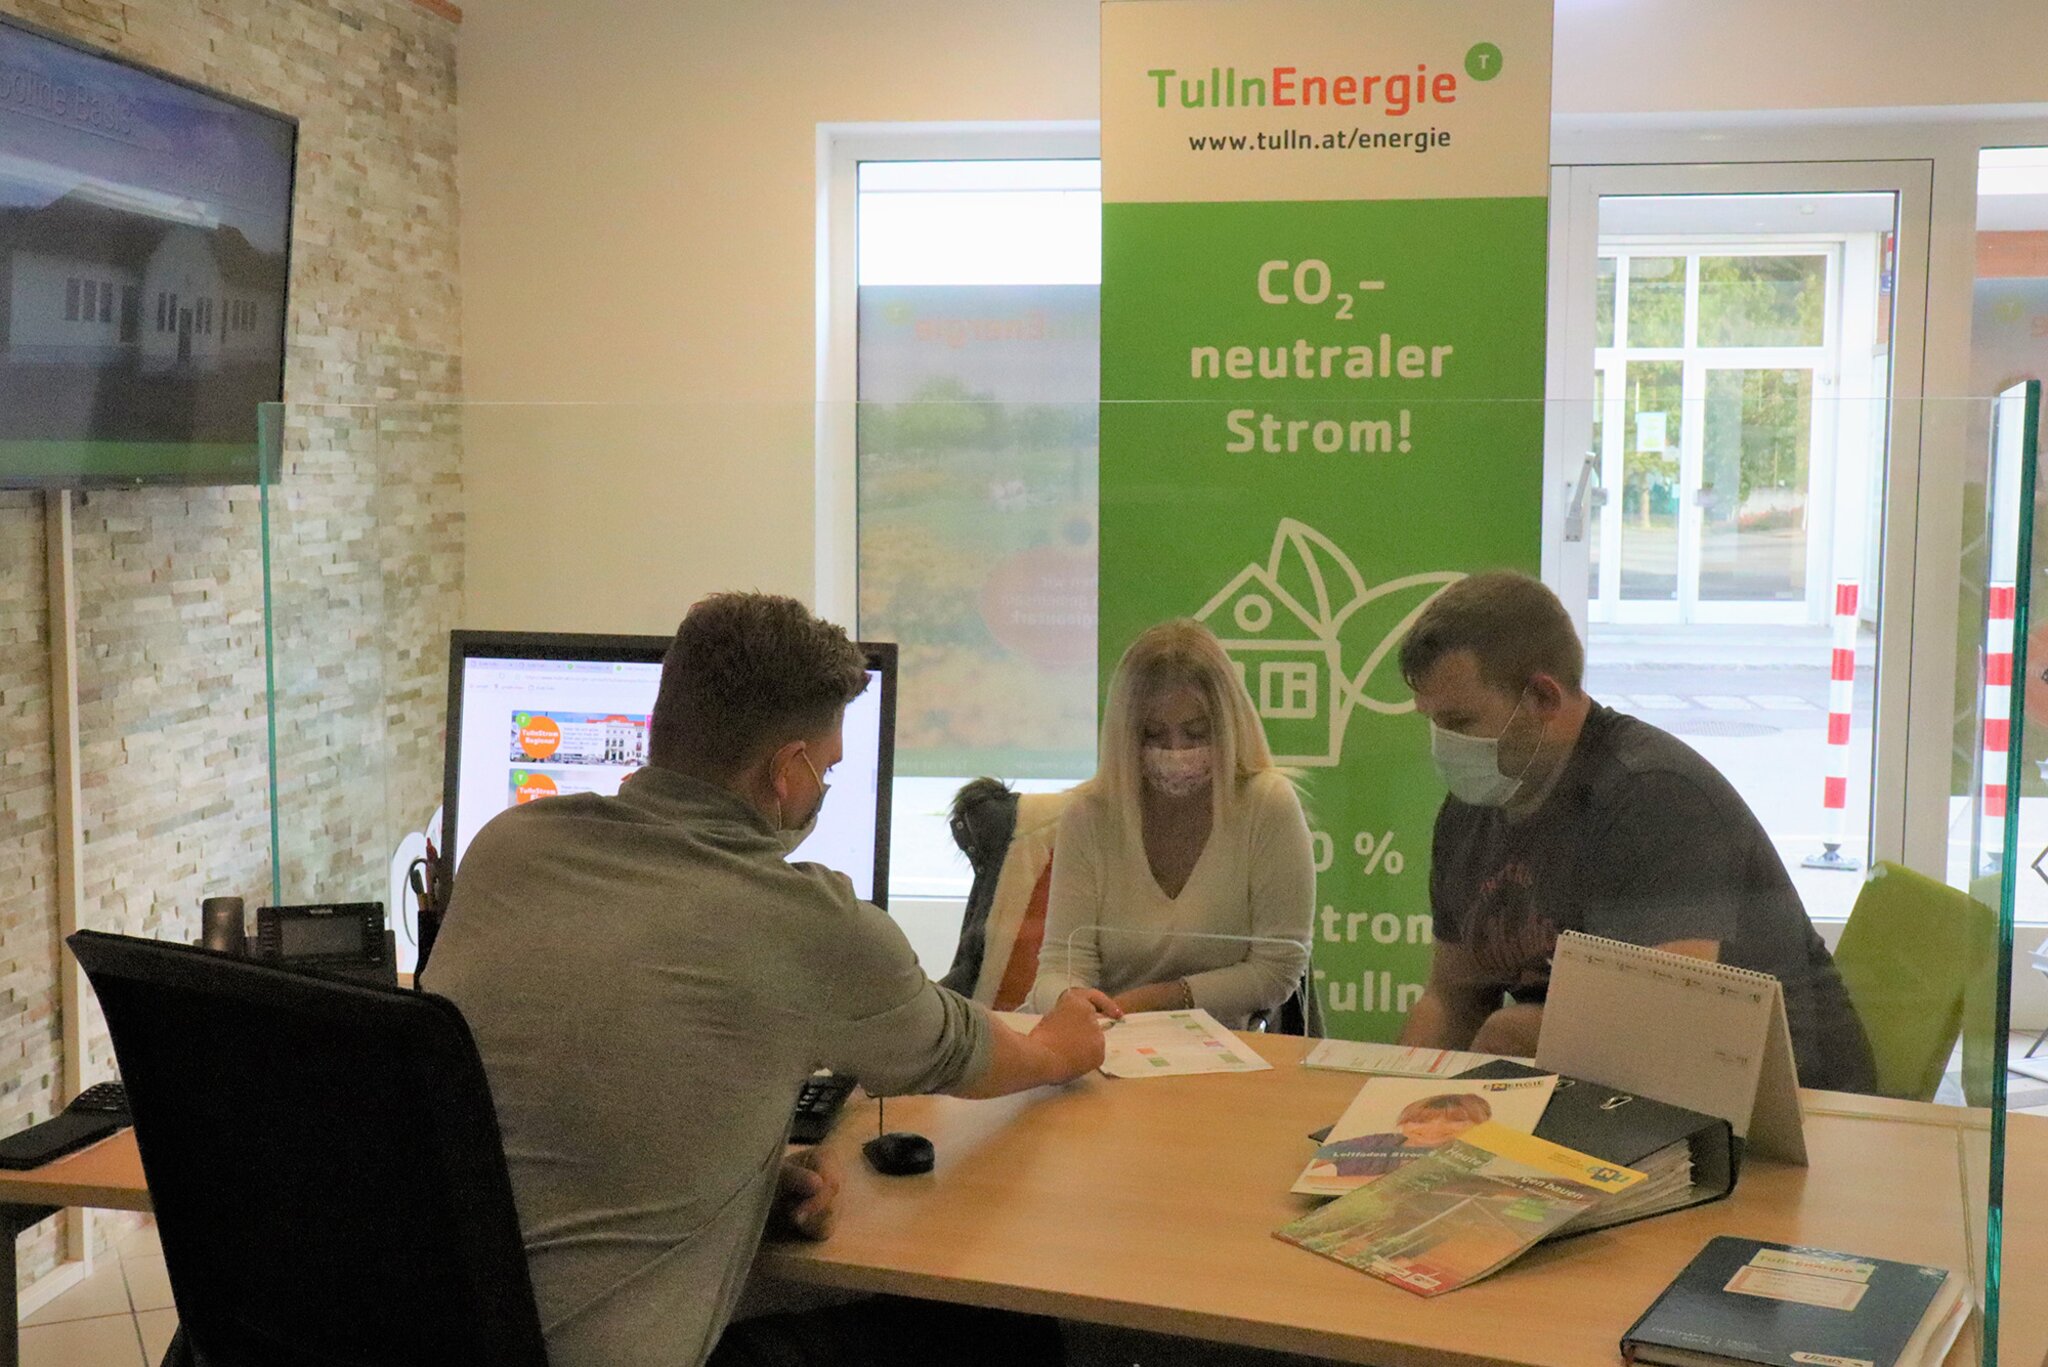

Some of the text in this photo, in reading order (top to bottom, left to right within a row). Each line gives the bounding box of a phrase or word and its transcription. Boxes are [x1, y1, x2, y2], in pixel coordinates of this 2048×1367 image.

[1147, 54, 1490, 116] TullnEnergie T
[1189, 127, 1451, 153] www.tulln.at/energie
[1191, 334, 1453, 379] neutraler
[1225, 408, 1412, 455] Strom!
[1355, 830, 1404, 875] %
